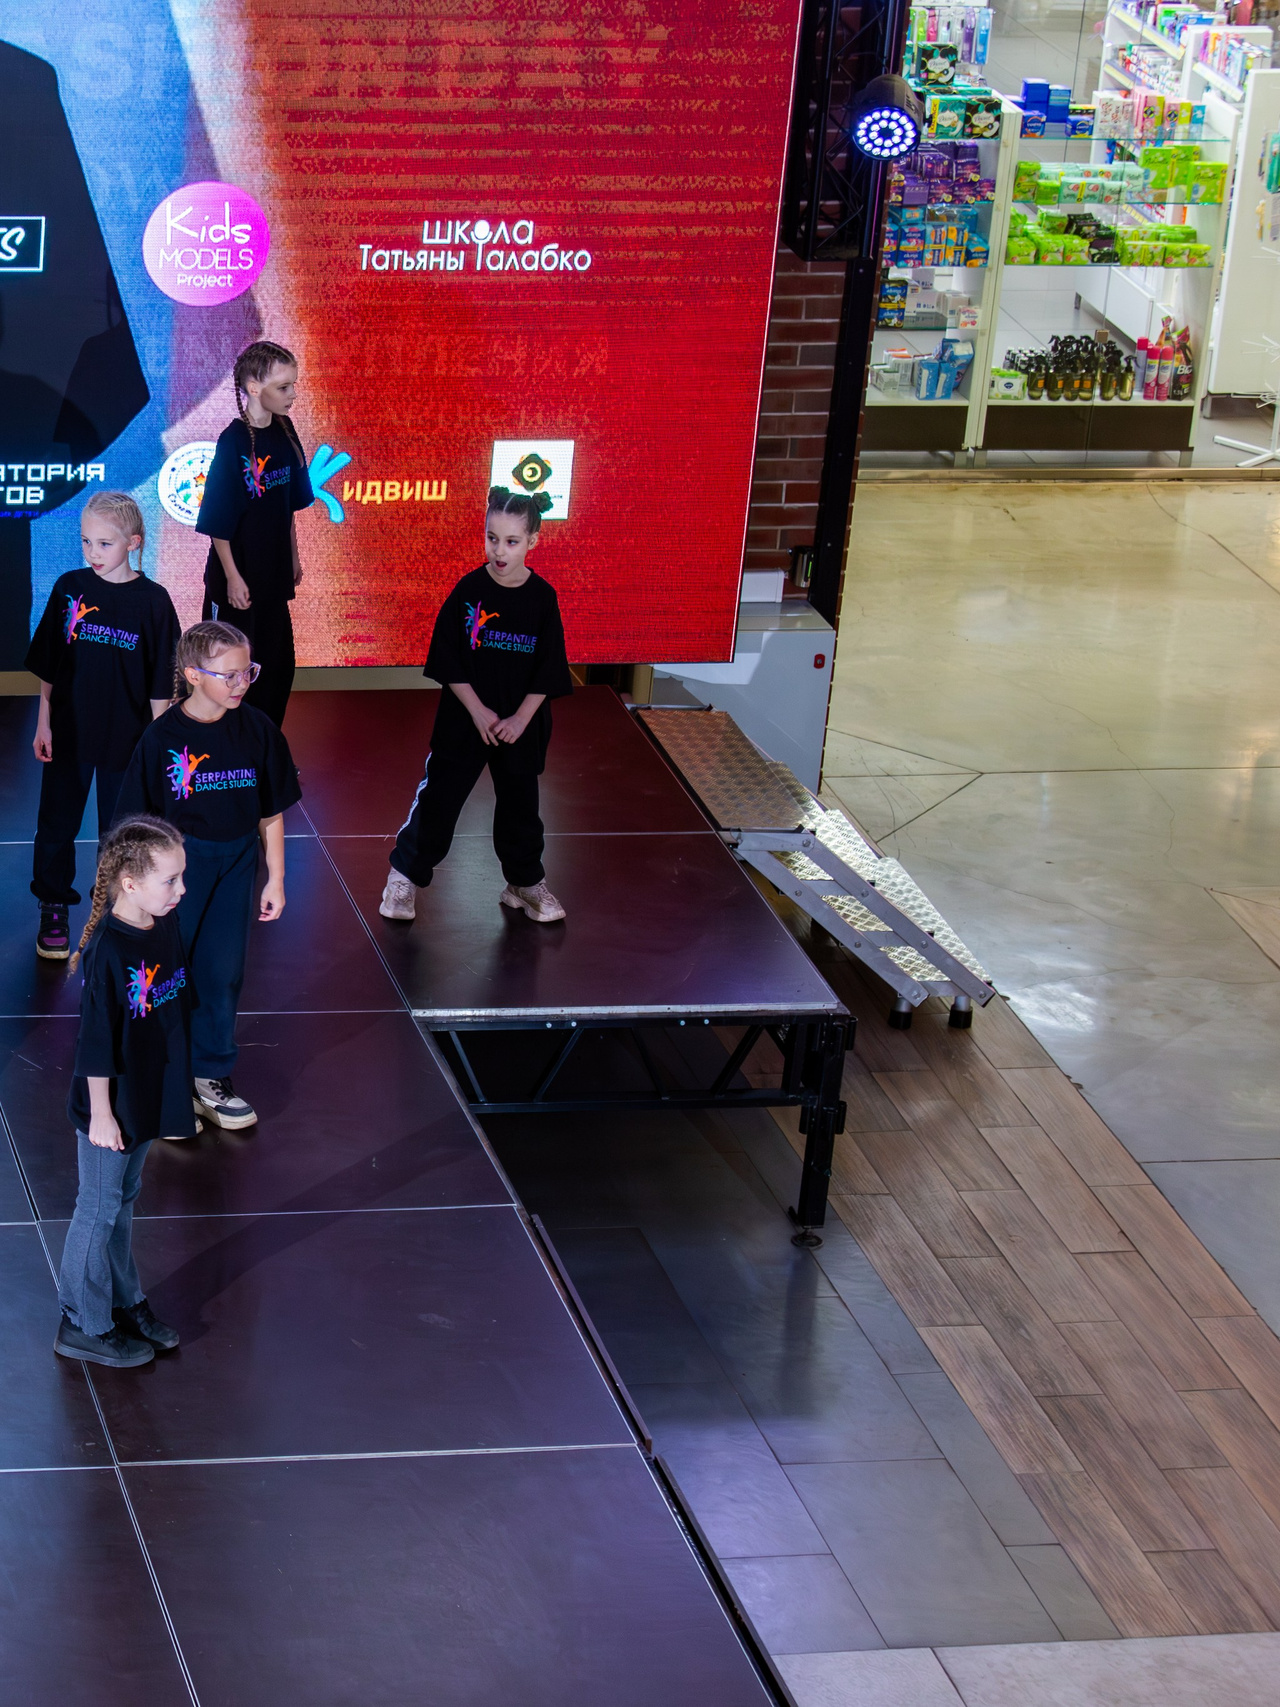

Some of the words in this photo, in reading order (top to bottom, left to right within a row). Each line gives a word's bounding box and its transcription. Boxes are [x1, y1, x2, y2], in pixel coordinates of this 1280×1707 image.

[165, 201, 252, 246] Kids
[159, 248, 254, 270] MODELS
[359, 244, 465, 271] Татьяны
[177, 273, 233, 289] Project
[79, 632, 110, 644] DANCE
[482, 639, 512, 651] DANCE
[195, 768, 256, 784] SERPANTINE
[195, 780, 228, 792] DANCE
[229, 778, 257, 789] STUDIO
